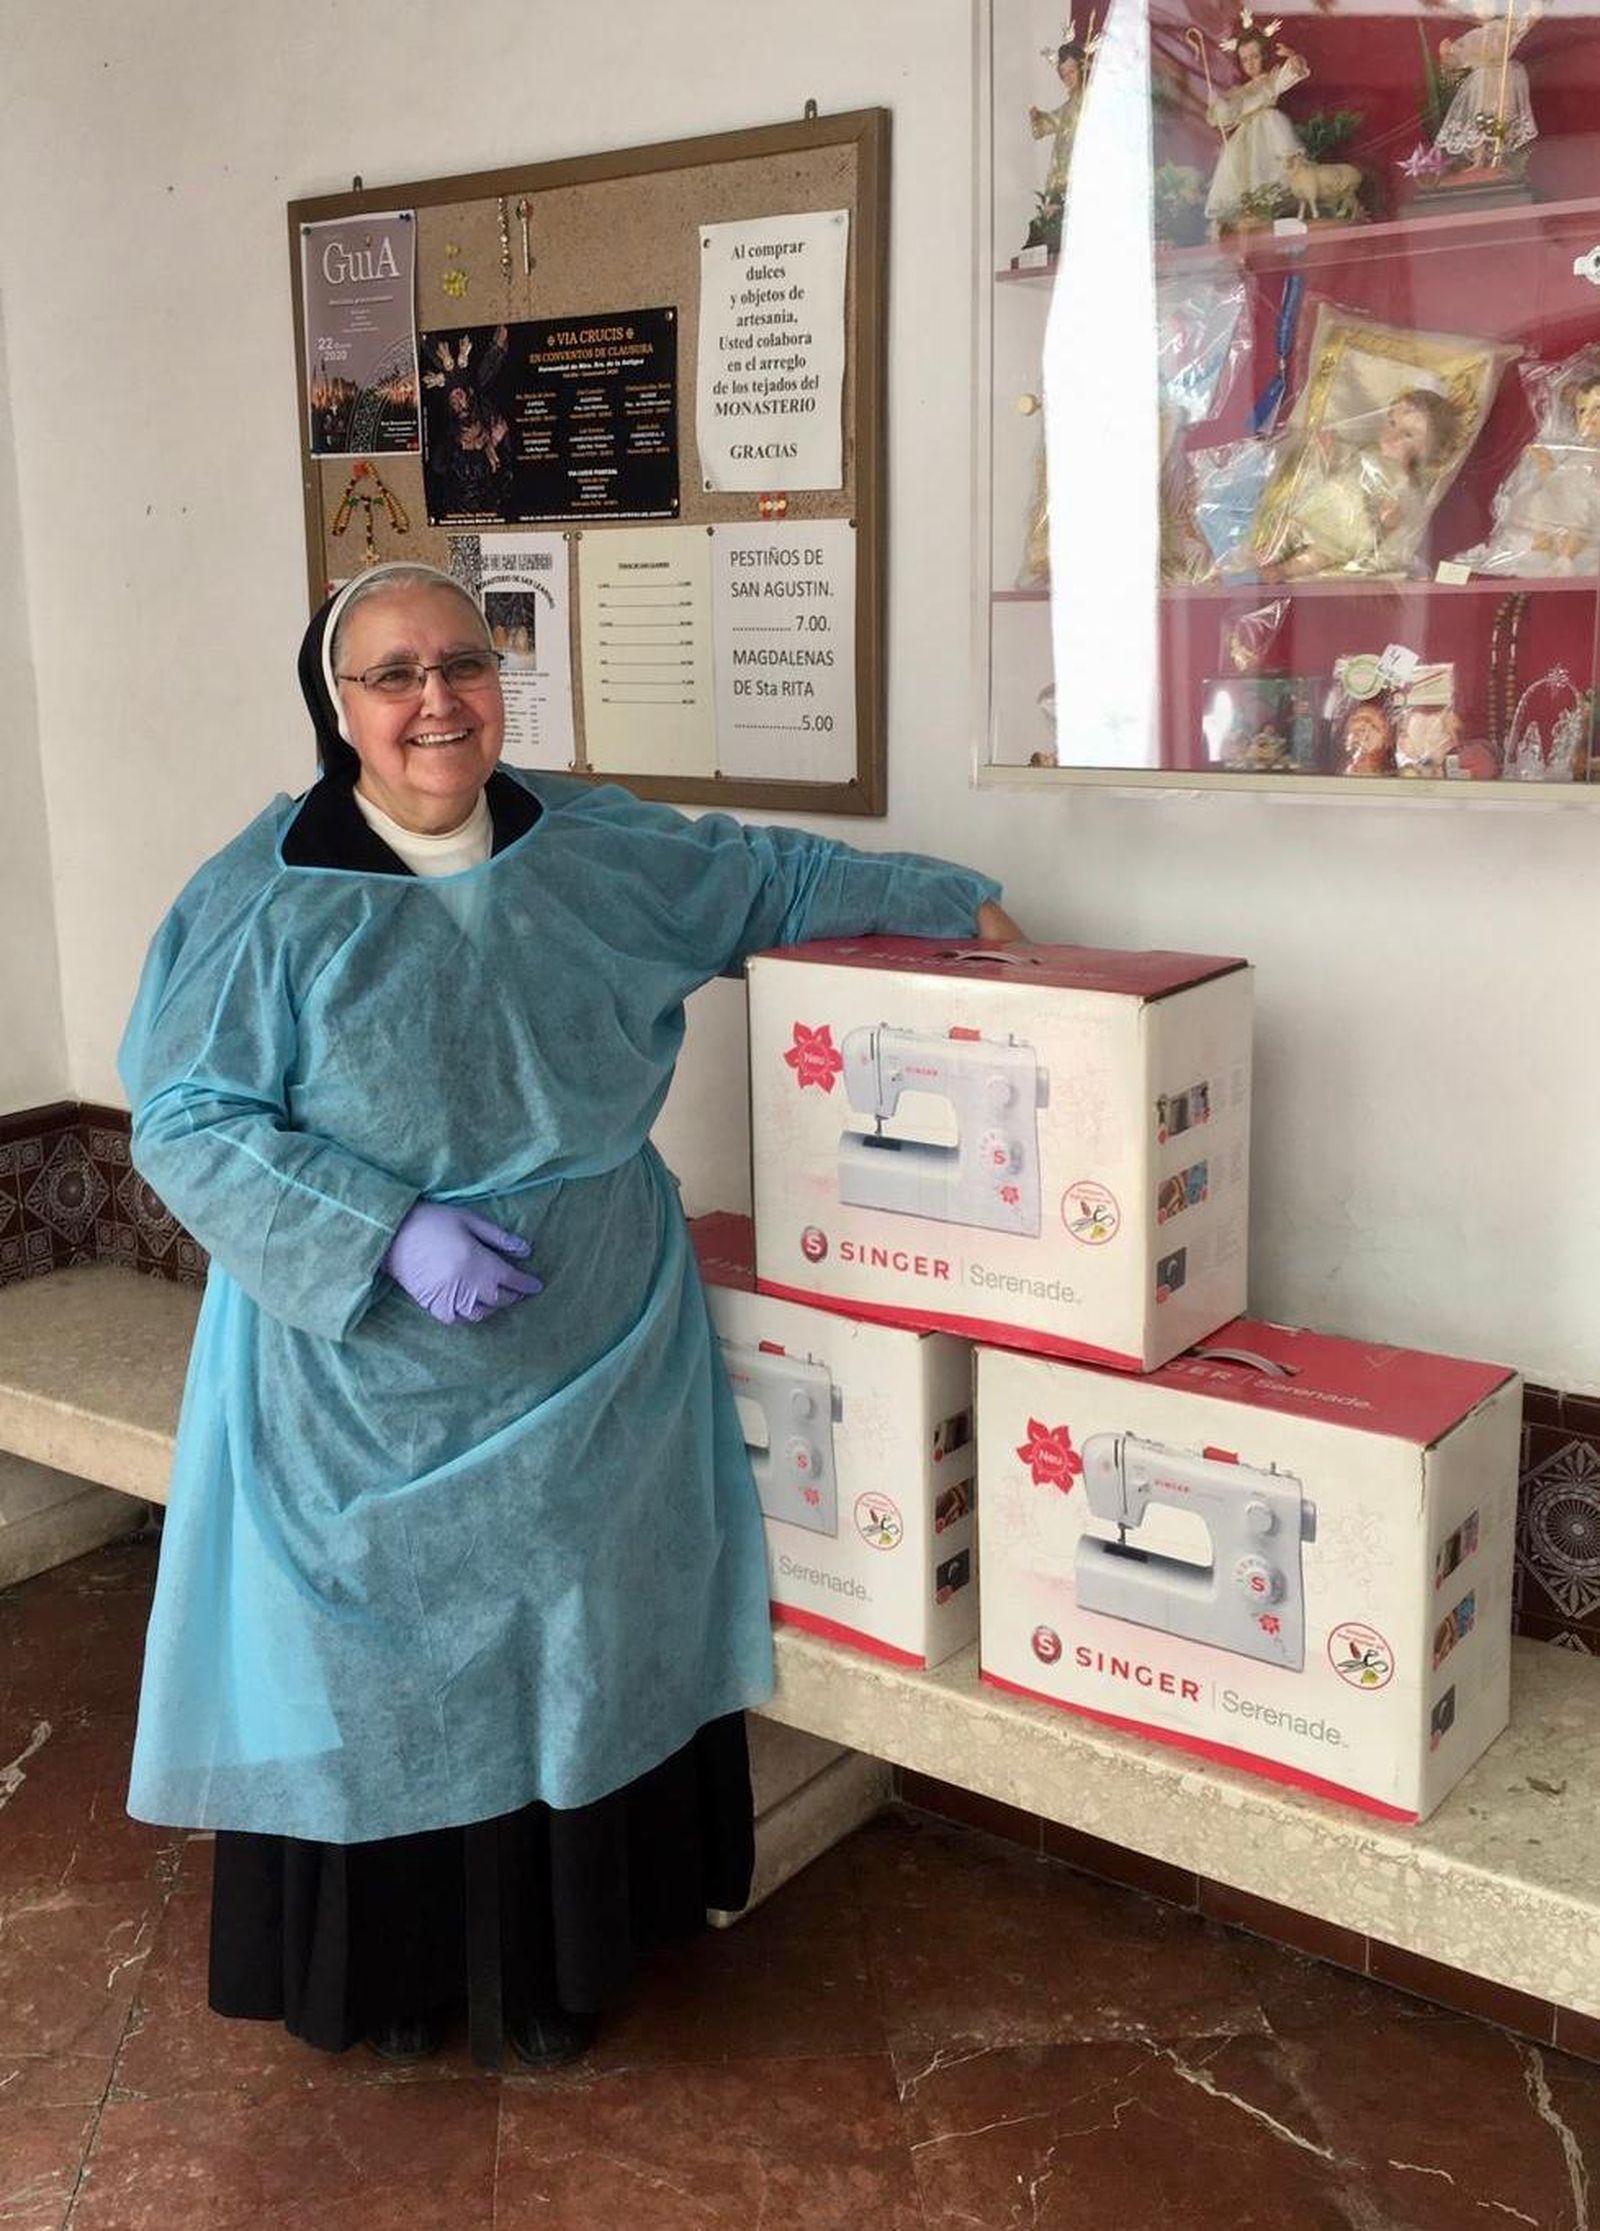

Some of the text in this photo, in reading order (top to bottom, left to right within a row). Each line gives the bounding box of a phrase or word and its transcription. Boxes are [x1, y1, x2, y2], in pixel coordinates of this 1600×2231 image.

[731, 242, 805, 260] Al comprar
[746, 265, 786, 281] dulces
[730, 285, 805, 310] y objetos de
[318, 337, 333, 350] 22
[557, 327, 624, 346] VIA CRUCIS
[720, 332, 812, 351] Usted colabora
[543, 349, 593, 363] CONVENTOS
[727, 354, 806, 372] en el arreglo
[713, 374, 819, 397] de los tejados del
[715, 397, 816, 416] MONASTERIO
[730, 443, 798, 460] GRACIAS
[730, 546, 824, 567] PESTIÑOS DE
[731, 581, 835, 598] SAN AGUSTIN.
[732, 649, 835, 667] MAGDALENAS
[734, 680, 815, 697] DE Sta RITA
[994, 1150, 1006, 1165] S
[840, 1241, 950, 1281] SINGER
[1251, 1576, 1265, 1592] S
[1075, 1646, 1200, 1702] SINGER
